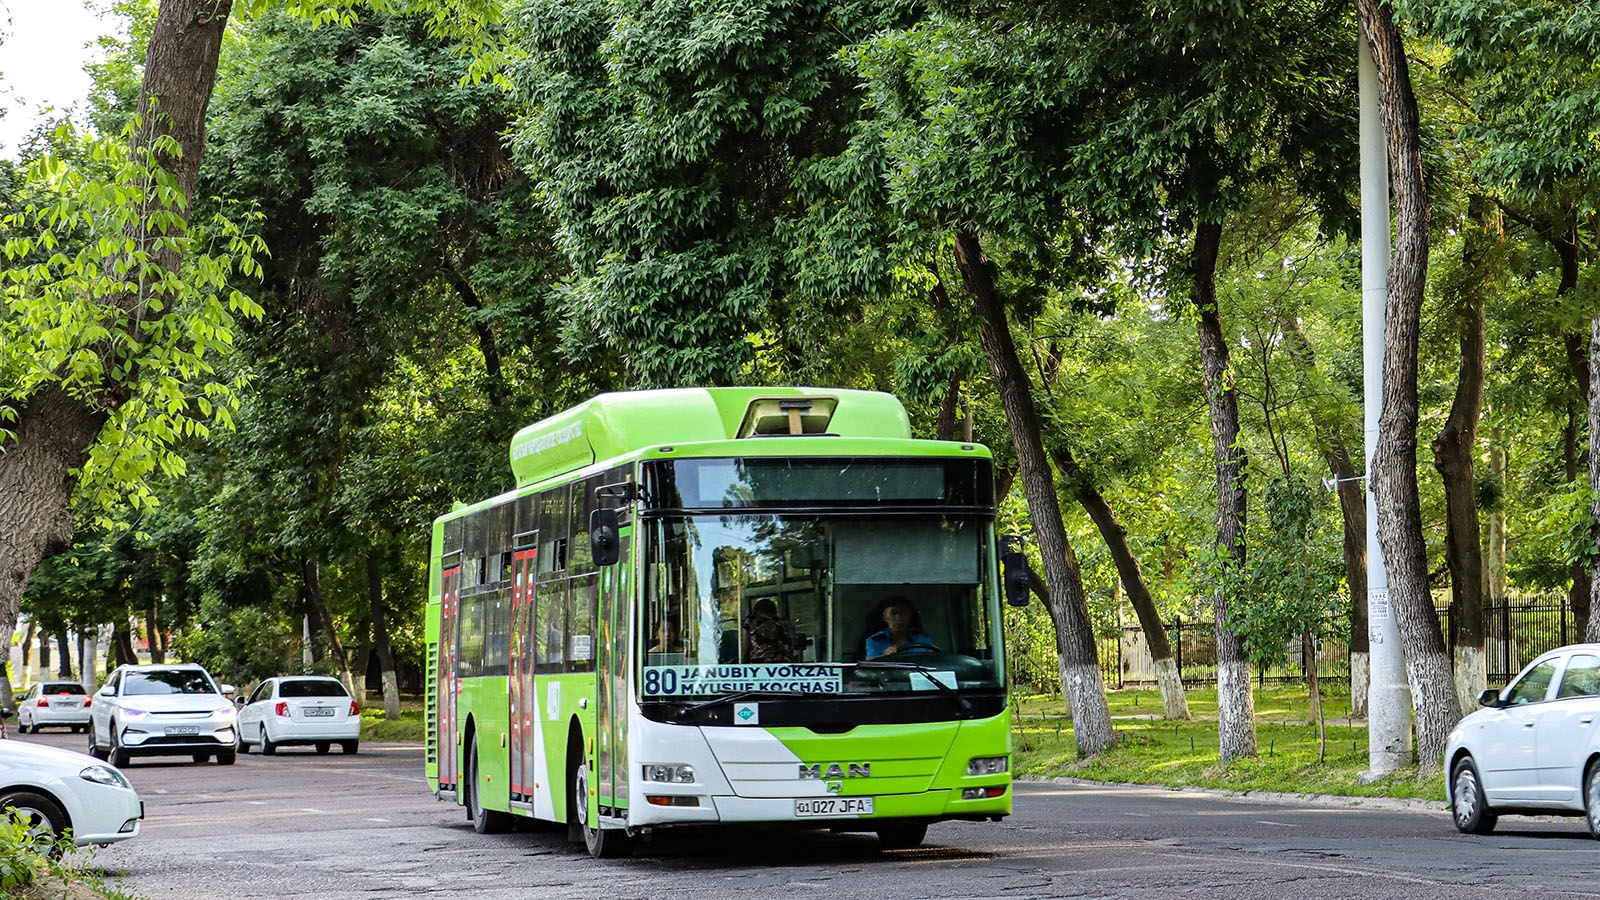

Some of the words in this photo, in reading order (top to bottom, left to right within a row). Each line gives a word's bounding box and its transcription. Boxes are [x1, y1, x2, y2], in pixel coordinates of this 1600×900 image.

[681, 667, 763, 679] JANUBIY
[765, 666, 839, 678] VOKZAL
[645, 668, 677, 695] 80
[798, 762, 870, 778] MAN
[799, 802, 810, 813] 01
[812, 801, 835, 813] 027
[839, 800, 865, 813] JFA
